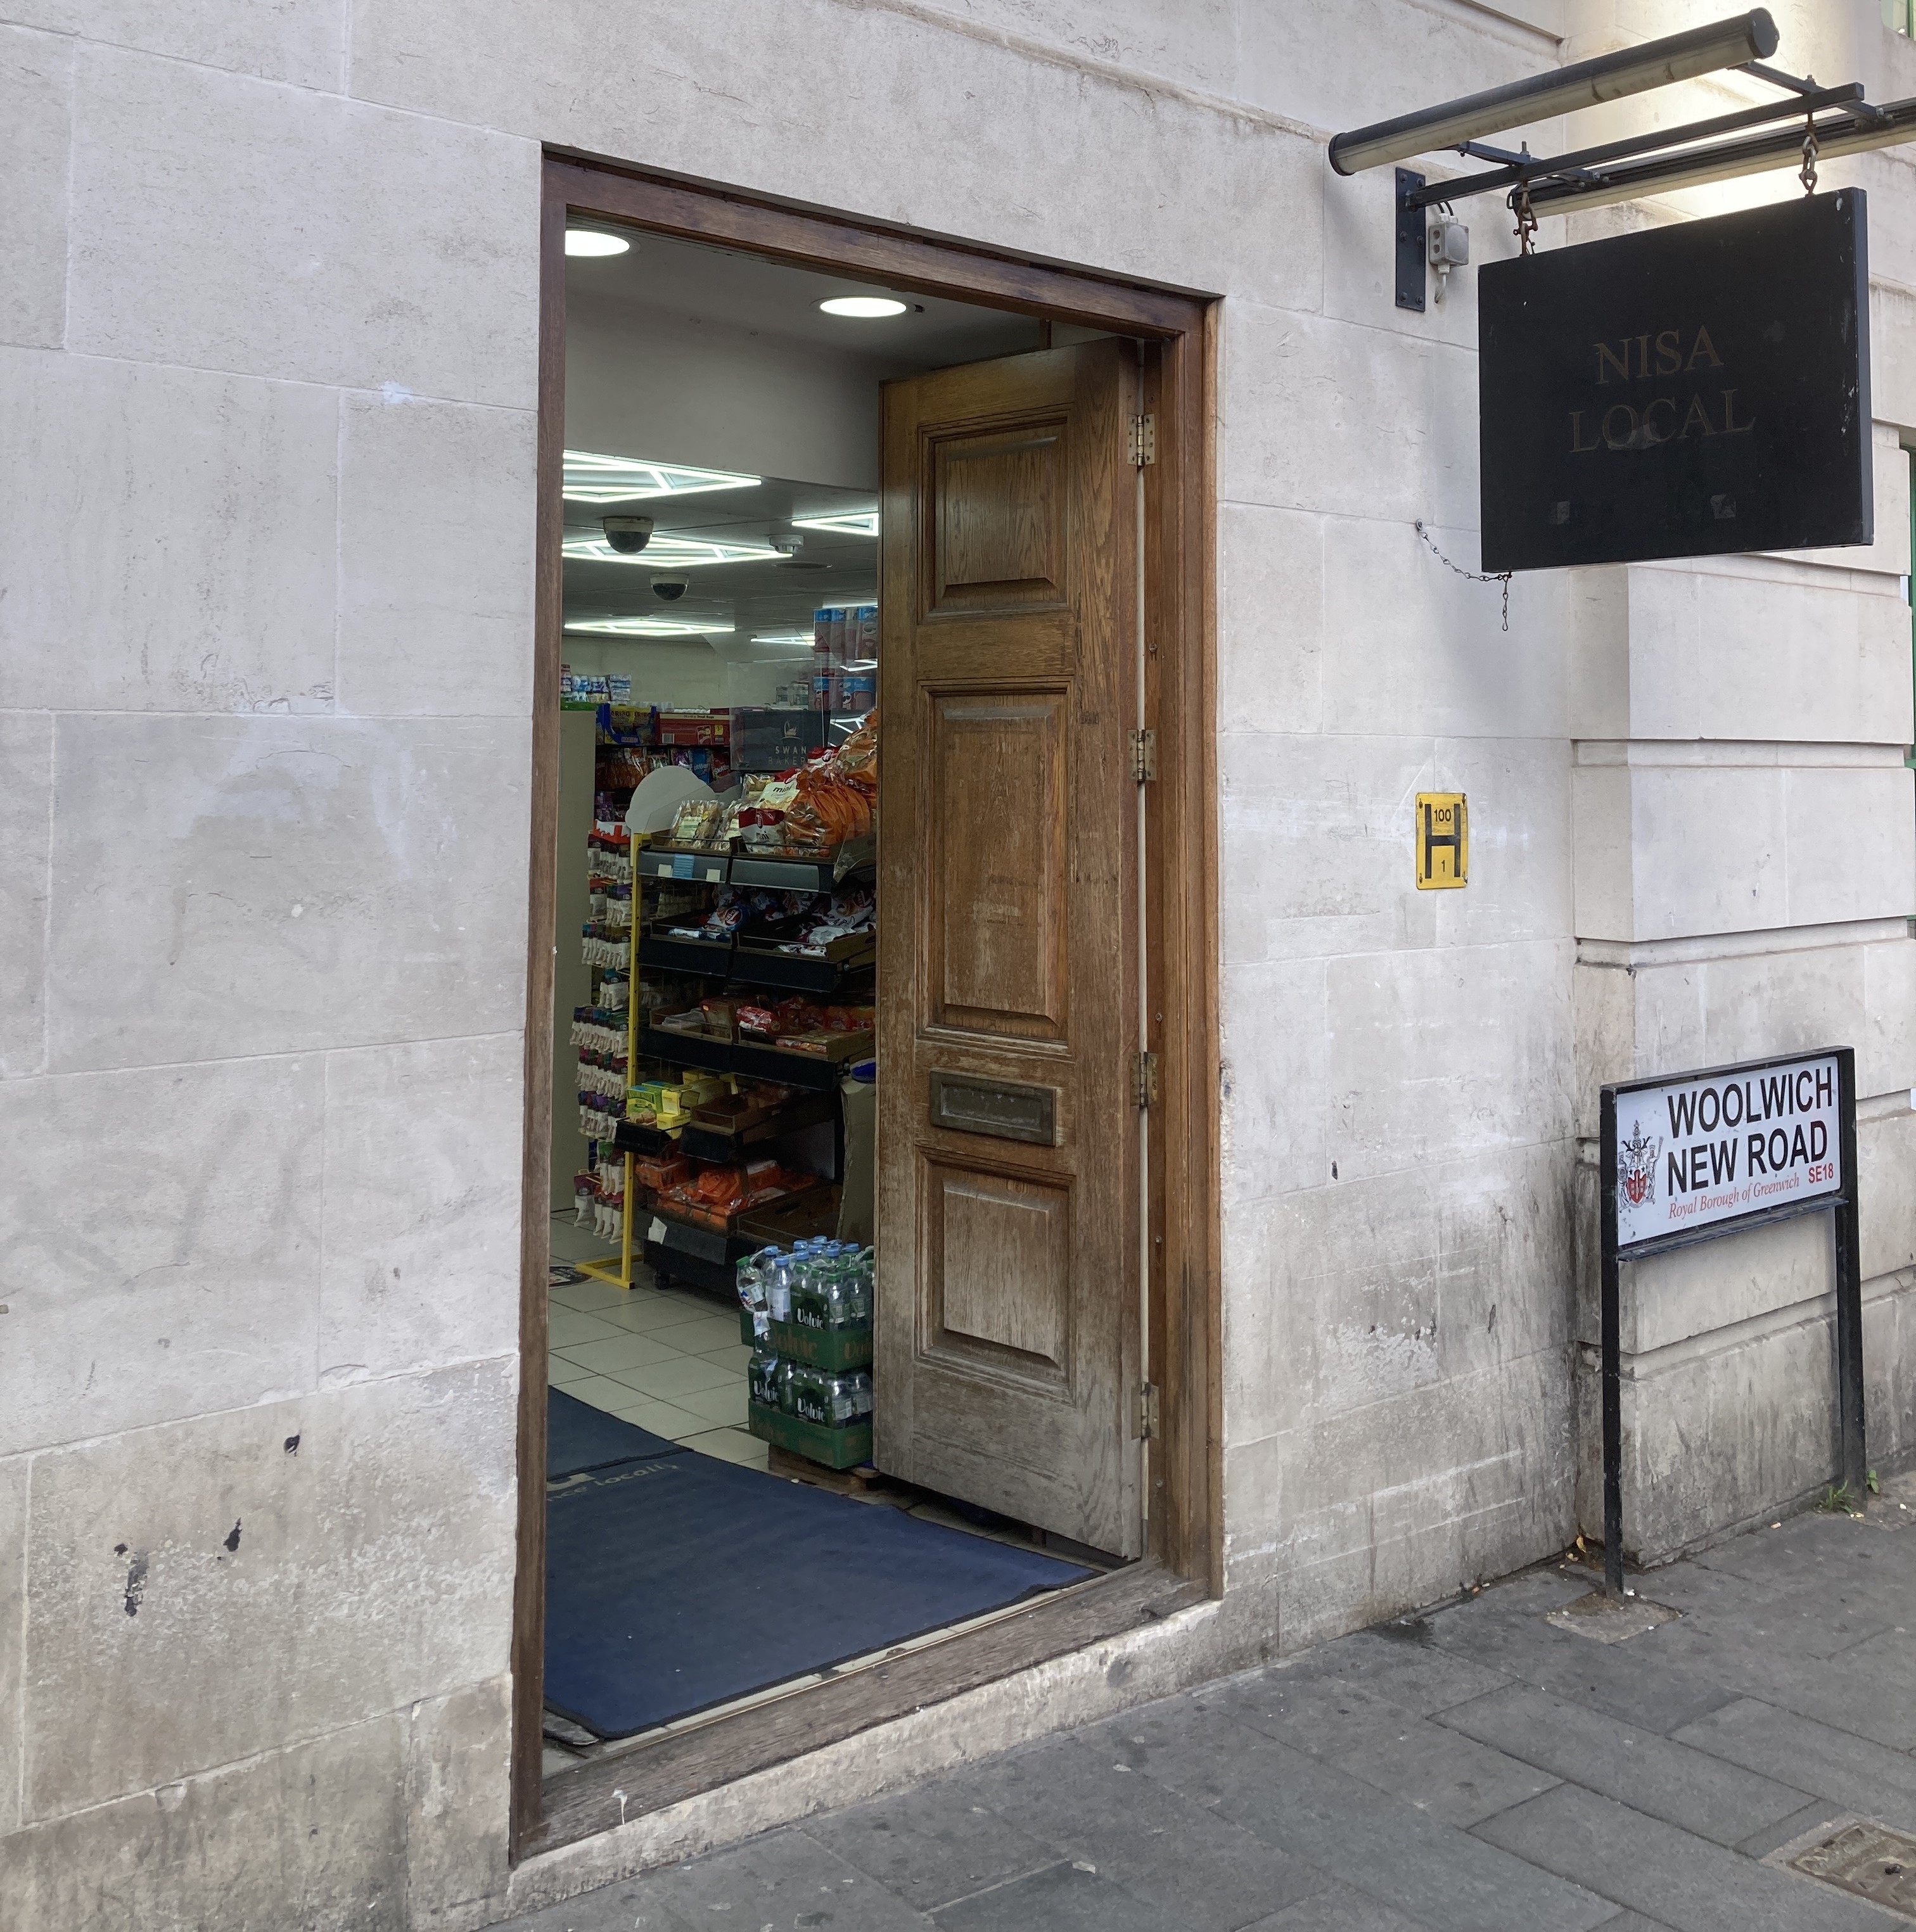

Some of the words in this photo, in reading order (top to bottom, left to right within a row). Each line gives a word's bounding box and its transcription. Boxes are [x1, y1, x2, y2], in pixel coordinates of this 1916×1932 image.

[1593, 324, 1725, 385] NISA
[1568, 388, 1756, 453] LOCAL
[768, 756, 806, 765] BAKER
[774, 745, 807, 755] SWAN
[1433, 809, 1452, 822] 100
[1424, 803, 1460, 879] H
[1441, 860, 1445, 872] 1
[1667, 1066, 1832, 1139] WOOLWICH
[1668, 1138, 1739, 1197] NEW
[1747, 1120, 1828, 1177] ROAD
[1808, 1162, 1834, 1185] SE18
[1668, 1197, 1697, 1219] Royal
[1699, 1186, 1739, 1212] Borough
[1742, 1183, 1754, 1203] of
[1753, 1172, 1800, 1198] Greenwich
[796, 1307, 824, 1330] Volvic
[797, 1397, 825, 1423] Volvic
